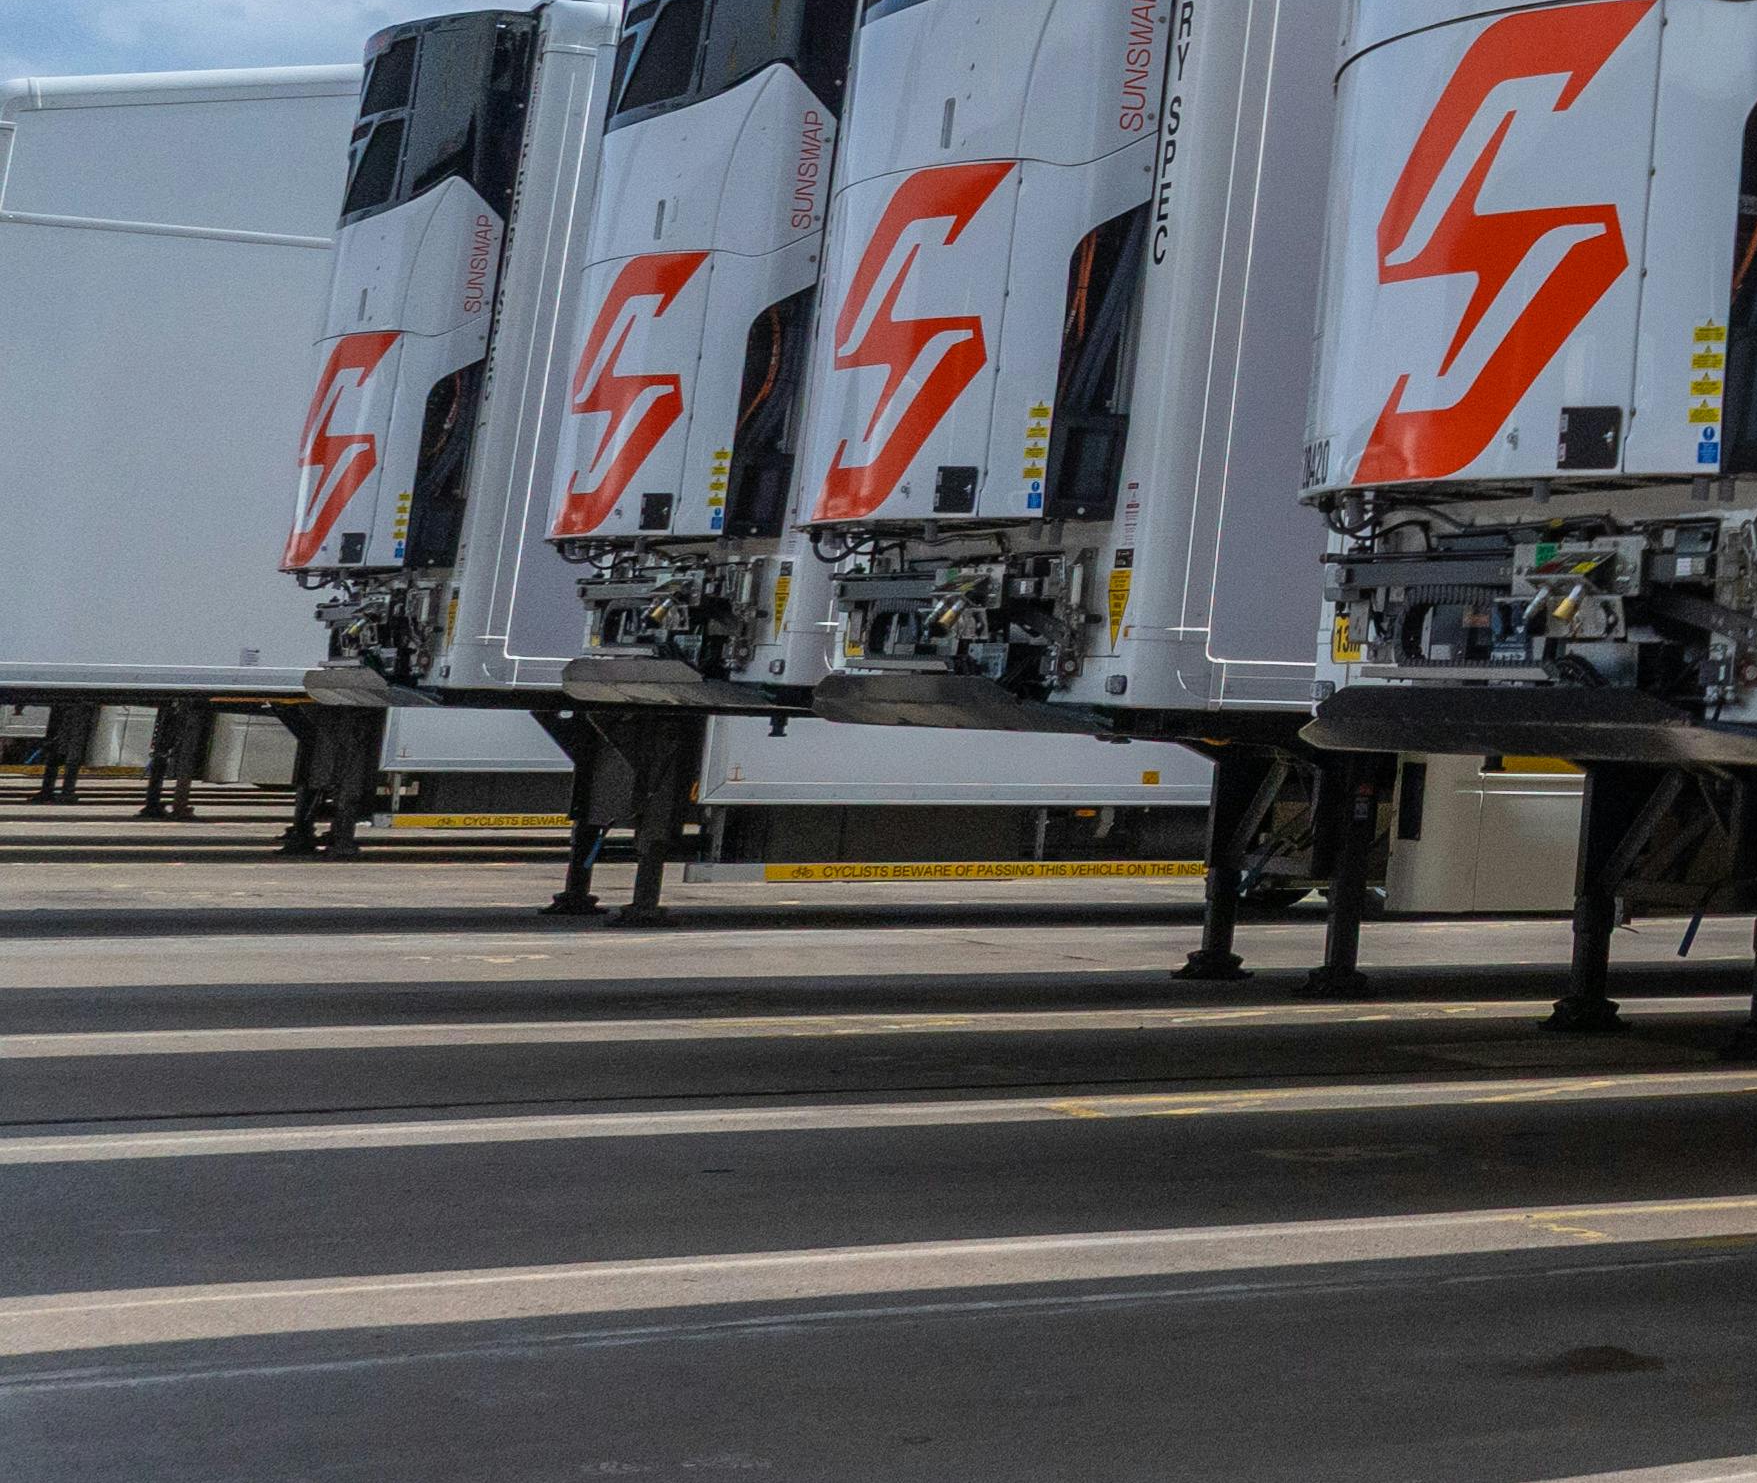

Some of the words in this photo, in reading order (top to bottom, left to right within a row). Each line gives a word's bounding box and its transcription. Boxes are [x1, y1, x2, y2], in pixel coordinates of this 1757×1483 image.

[791, 110, 824, 230] SUNSWAP
[1153, 95, 1182, 265] SPEC
[464, 214, 493, 313] SUNSWAP
[463, 816, 518, 827] CYCLISTS
[823, 865, 889, 878] CYCLISTS
[892, 865, 951, 877] BEWARE
[955, 864, 974, 877] OF
[977, 864, 1034, 877] PASSING
[1039, 864, 1067, 876] THIS
[1071, 863, 1124, 876] VEHICLE
[1127, 863, 1147, 875] ON
[1151, 863, 1173, 875] THE
